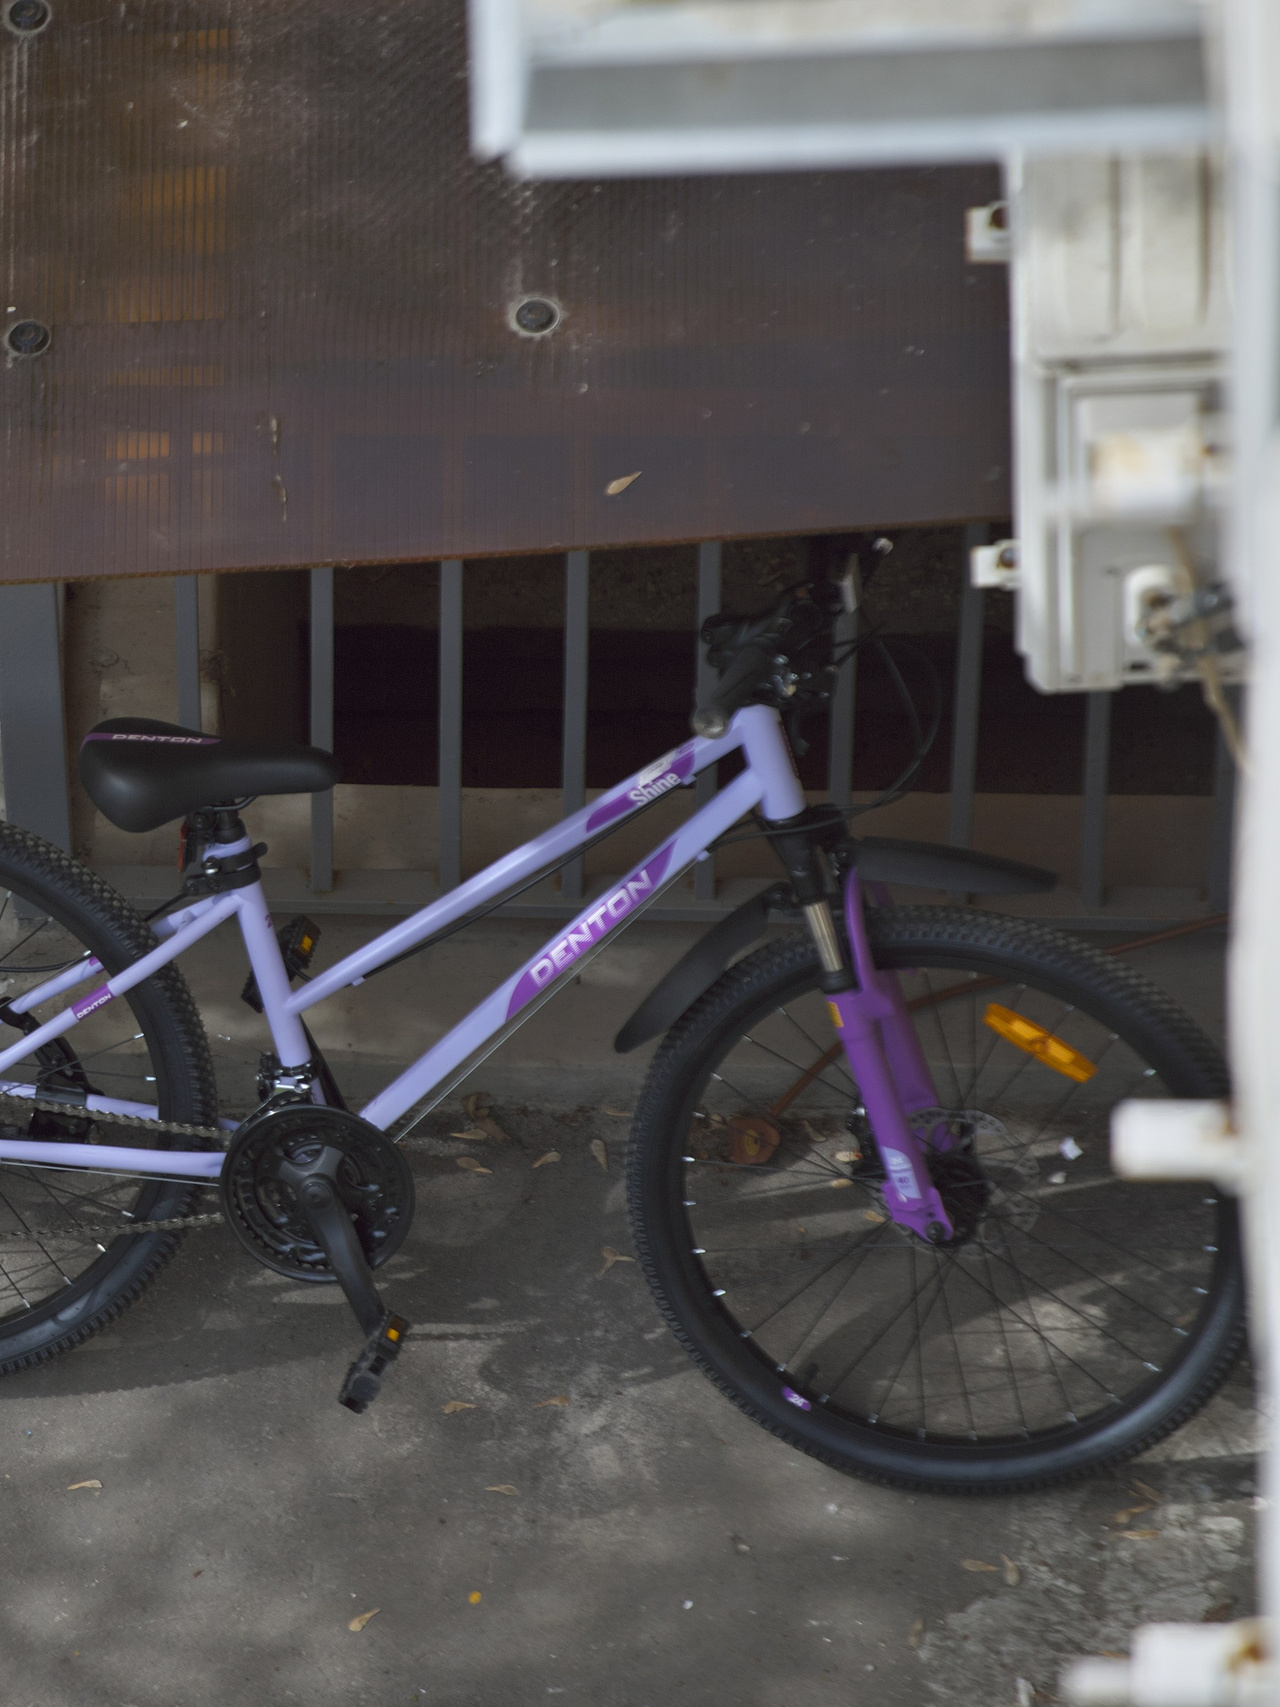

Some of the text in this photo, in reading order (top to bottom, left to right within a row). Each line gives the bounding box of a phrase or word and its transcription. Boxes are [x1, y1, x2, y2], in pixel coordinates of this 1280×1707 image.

[112, 734, 202, 743] DENTON
[629, 772, 681, 806] Shine
[529, 868, 653, 989] DENTON
[76, 993, 112, 1019] DENTON
